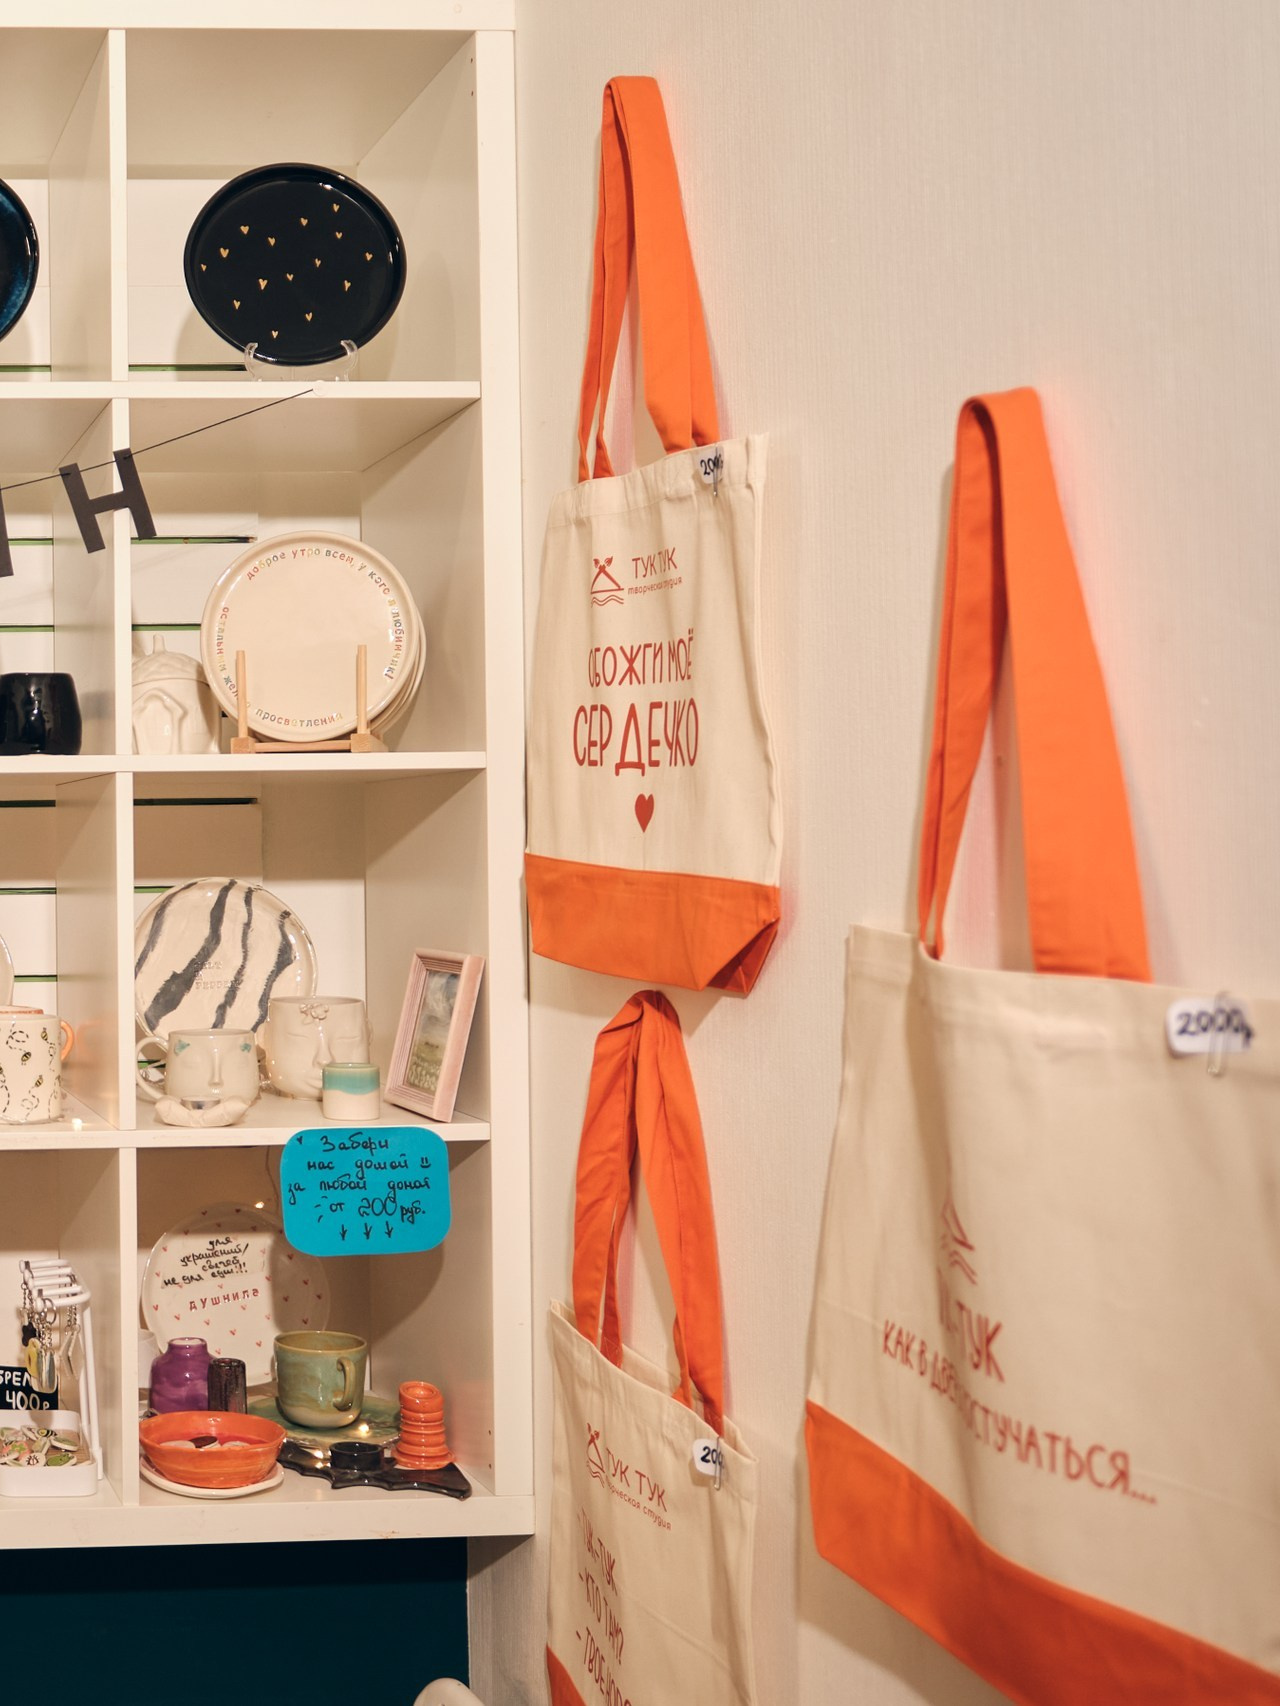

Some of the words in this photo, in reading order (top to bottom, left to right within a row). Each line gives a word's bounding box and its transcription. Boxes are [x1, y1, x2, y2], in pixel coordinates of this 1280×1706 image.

[247, 552, 287, 581] доброе
[291, 548, 321, 560] утро
[325, 549, 355, 568] всем,
[368, 570, 391, 595] кого
[632, 554, 657, 579] ТУК
[588, 641, 663, 688] ОБОЖГИ
[668, 628, 694, 682] МОЁ
[256, 708, 344, 728] просветления
[573, 697, 699, 777] СЕРДЕЧКО
[320, 1131, 389, 1156] Забери
[307, 1161, 335, 1171] нас
[355, 1153, 408, 1180] домой
[288, 1182, 306, 1205] за
[320, 1173, 367, 1190] любой
[330, 1202, 345, 1213] от
[358, 1197, 397, 1217] 200
[400, 1200, 426, 1224] руб.
[189, 1288, 260, 1311] душнила
[883, 1319, 915, 1370] КАК
[918, 1340, 928, 1376] В
[606, 1447, 630, 1488] ТУК
[634, 1470, 668, 1512] ТУК
